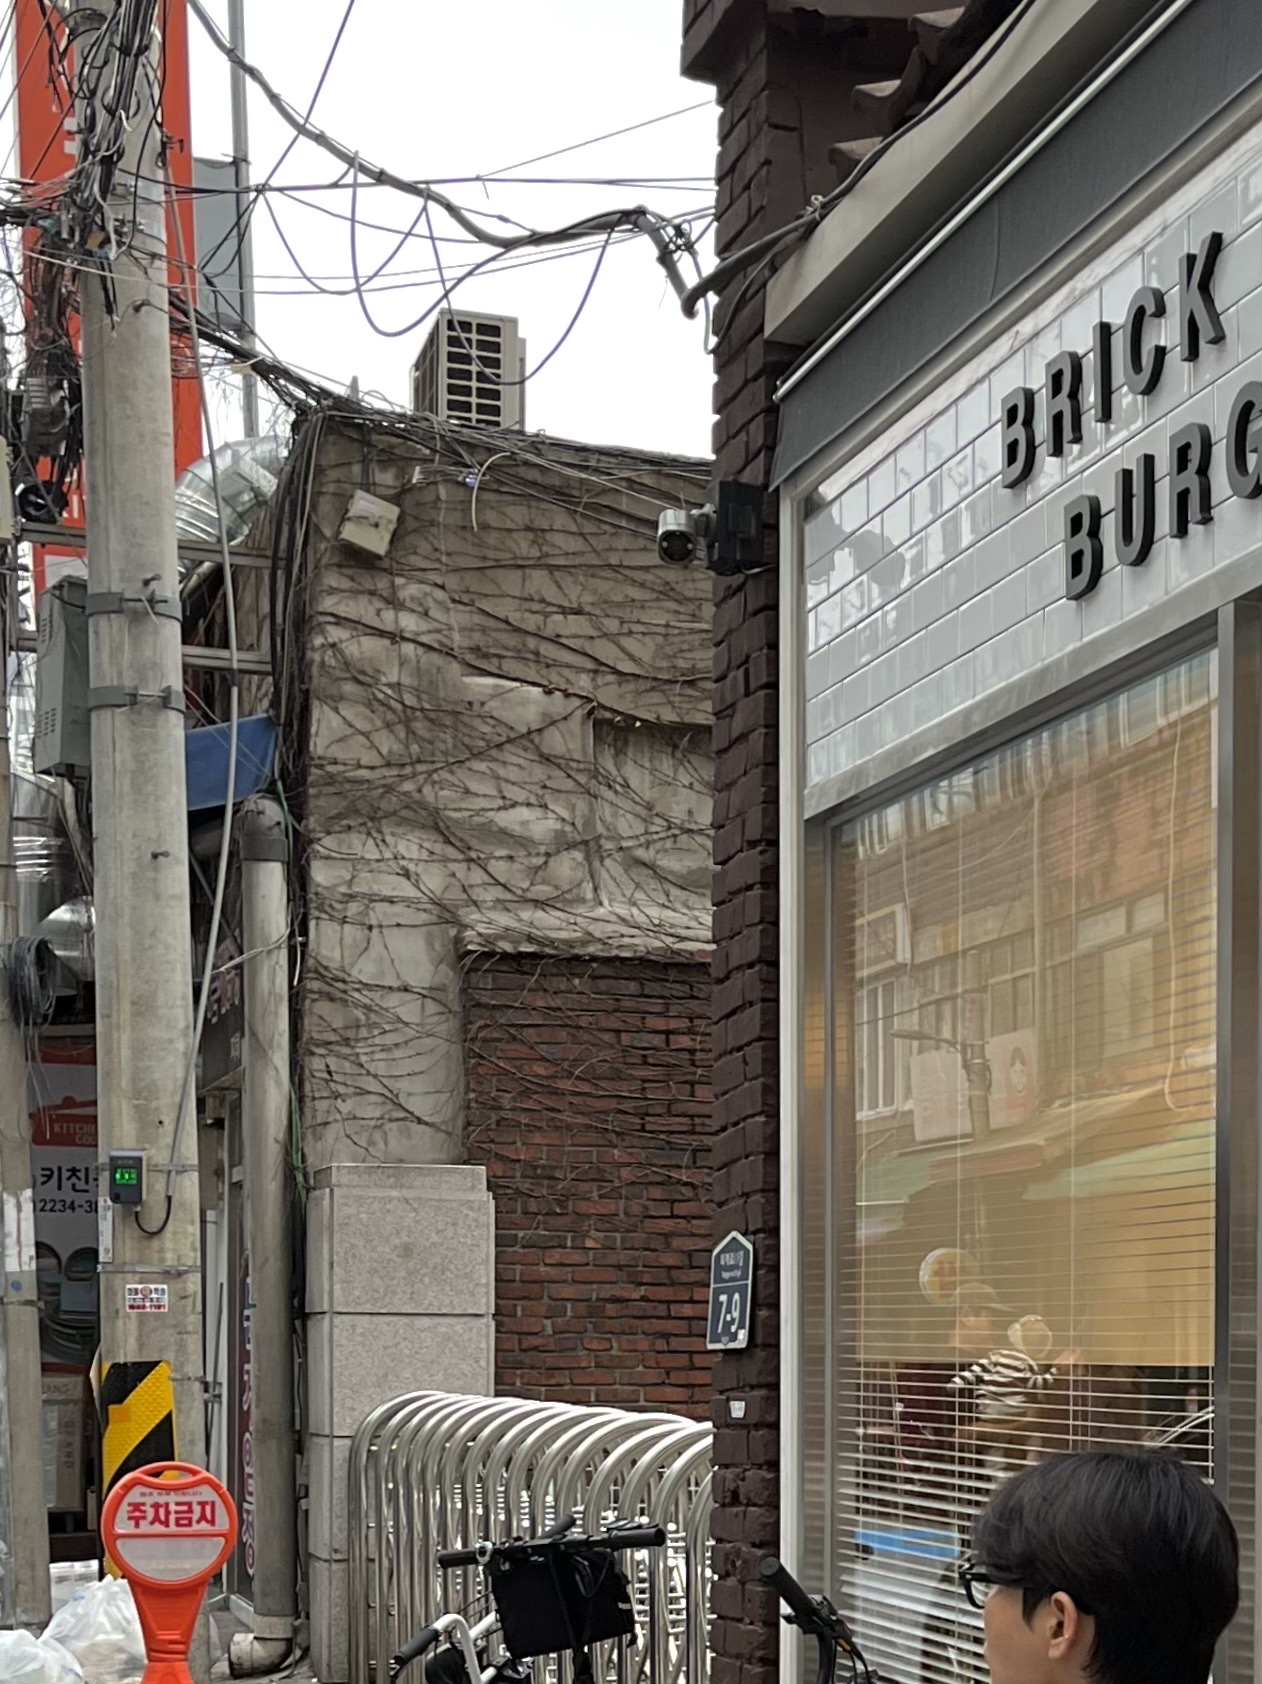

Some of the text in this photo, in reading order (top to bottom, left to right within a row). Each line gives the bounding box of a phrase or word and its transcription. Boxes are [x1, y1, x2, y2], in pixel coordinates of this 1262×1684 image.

[1001, 231, 1225, 489] BRICK
[40, 1166, 98, 1193] 키친
[717, 1292, 740, 1333] 7-9
[127, 1500, 216, 1528] 주차금지
